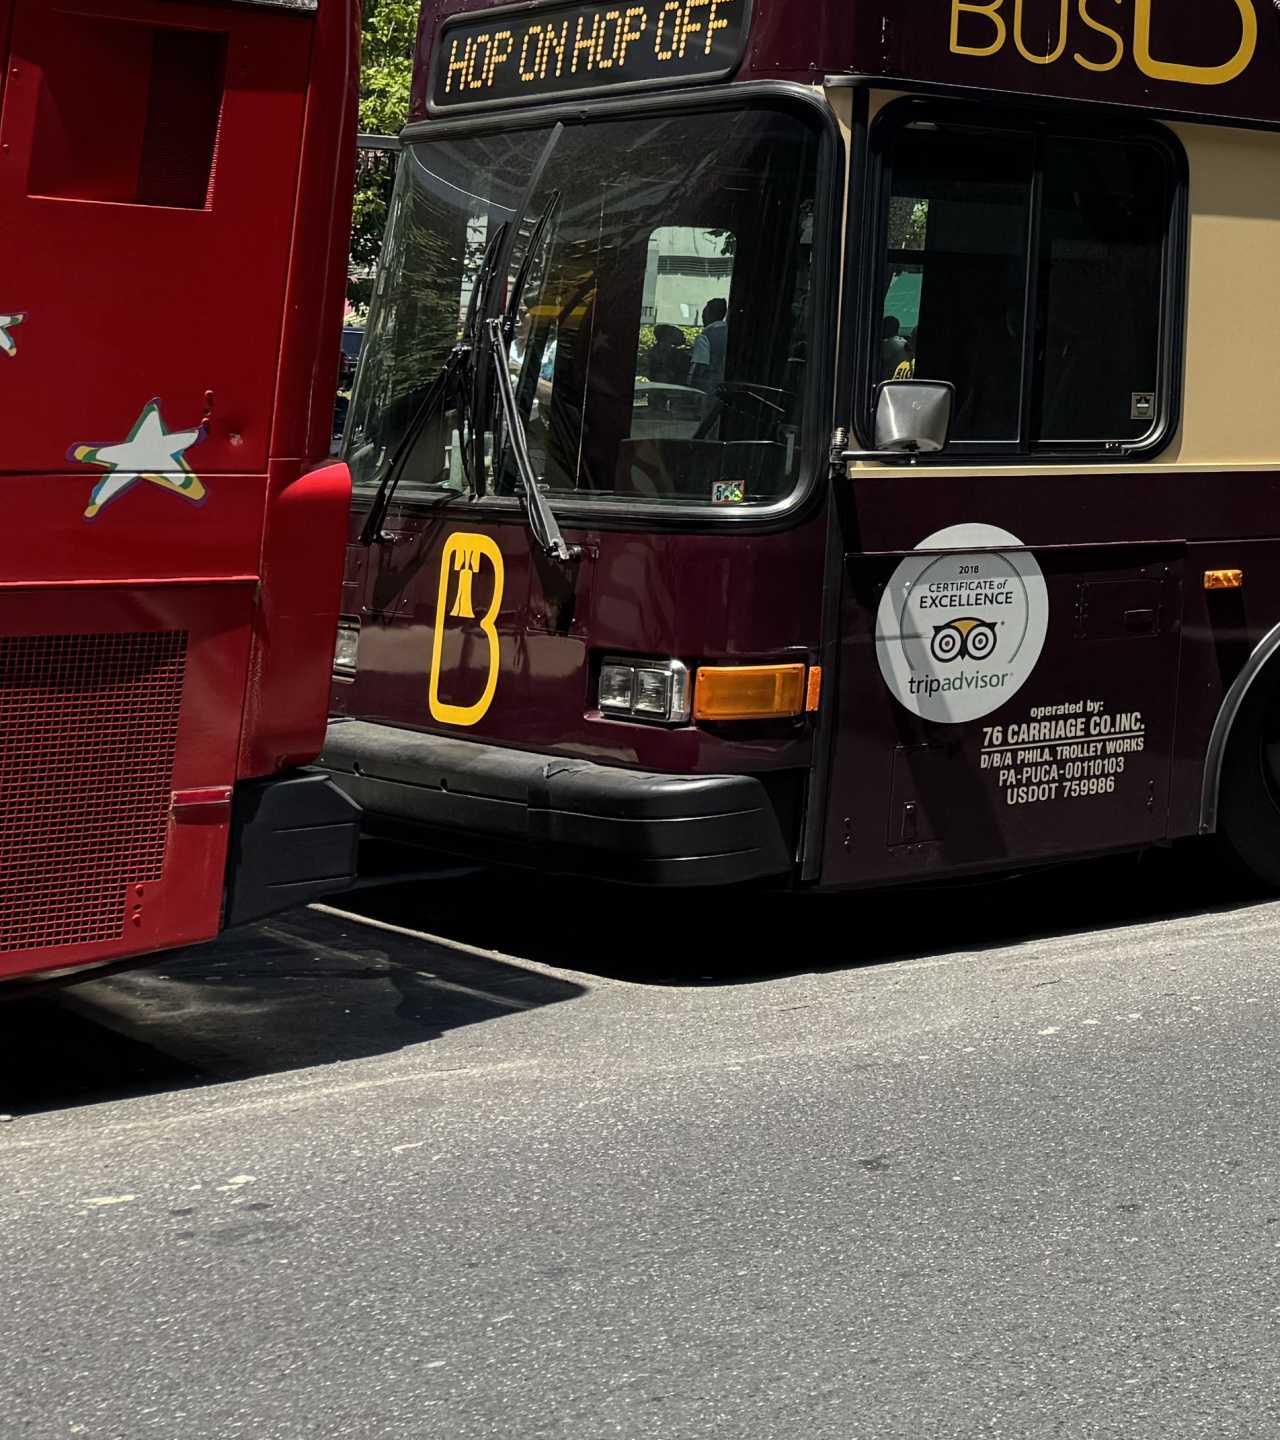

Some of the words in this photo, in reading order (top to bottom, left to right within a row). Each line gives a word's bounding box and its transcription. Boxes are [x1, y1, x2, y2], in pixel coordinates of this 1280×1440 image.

[444, 29, 514, 94] HOP
[518, 20, 569, 82] ON
[570, 6, 648, 73] HOP
[959, 564, 980, 575] 2018
[919, 591, 1014, 609] EXCELLENCE
[928, 580, 995, 593] CERTIFICATE
[996, 578, 1009, 590] of
[908, 670, 1009, 698] tripadvisor
[1030, 700, 1084, 720] operated
[1086, 699, 1105, 713] by:
[982, 726, 1003, 747] 76
[1007, 717, 1086, 745] CARRIAGE
[980, 751, 1013, 769] D/B/A
[1016, 747, 1054, 765] PHILA.
[1056, 742, 1103, 760] TROLLEY
[1105, 737, 1145, 755] WORKS
[998, 756, 1126, 787] PA-PUCA-00110103
[1006, 782, 1060, 805] USDOT
[1062, 775, 1116, 799] 759986
